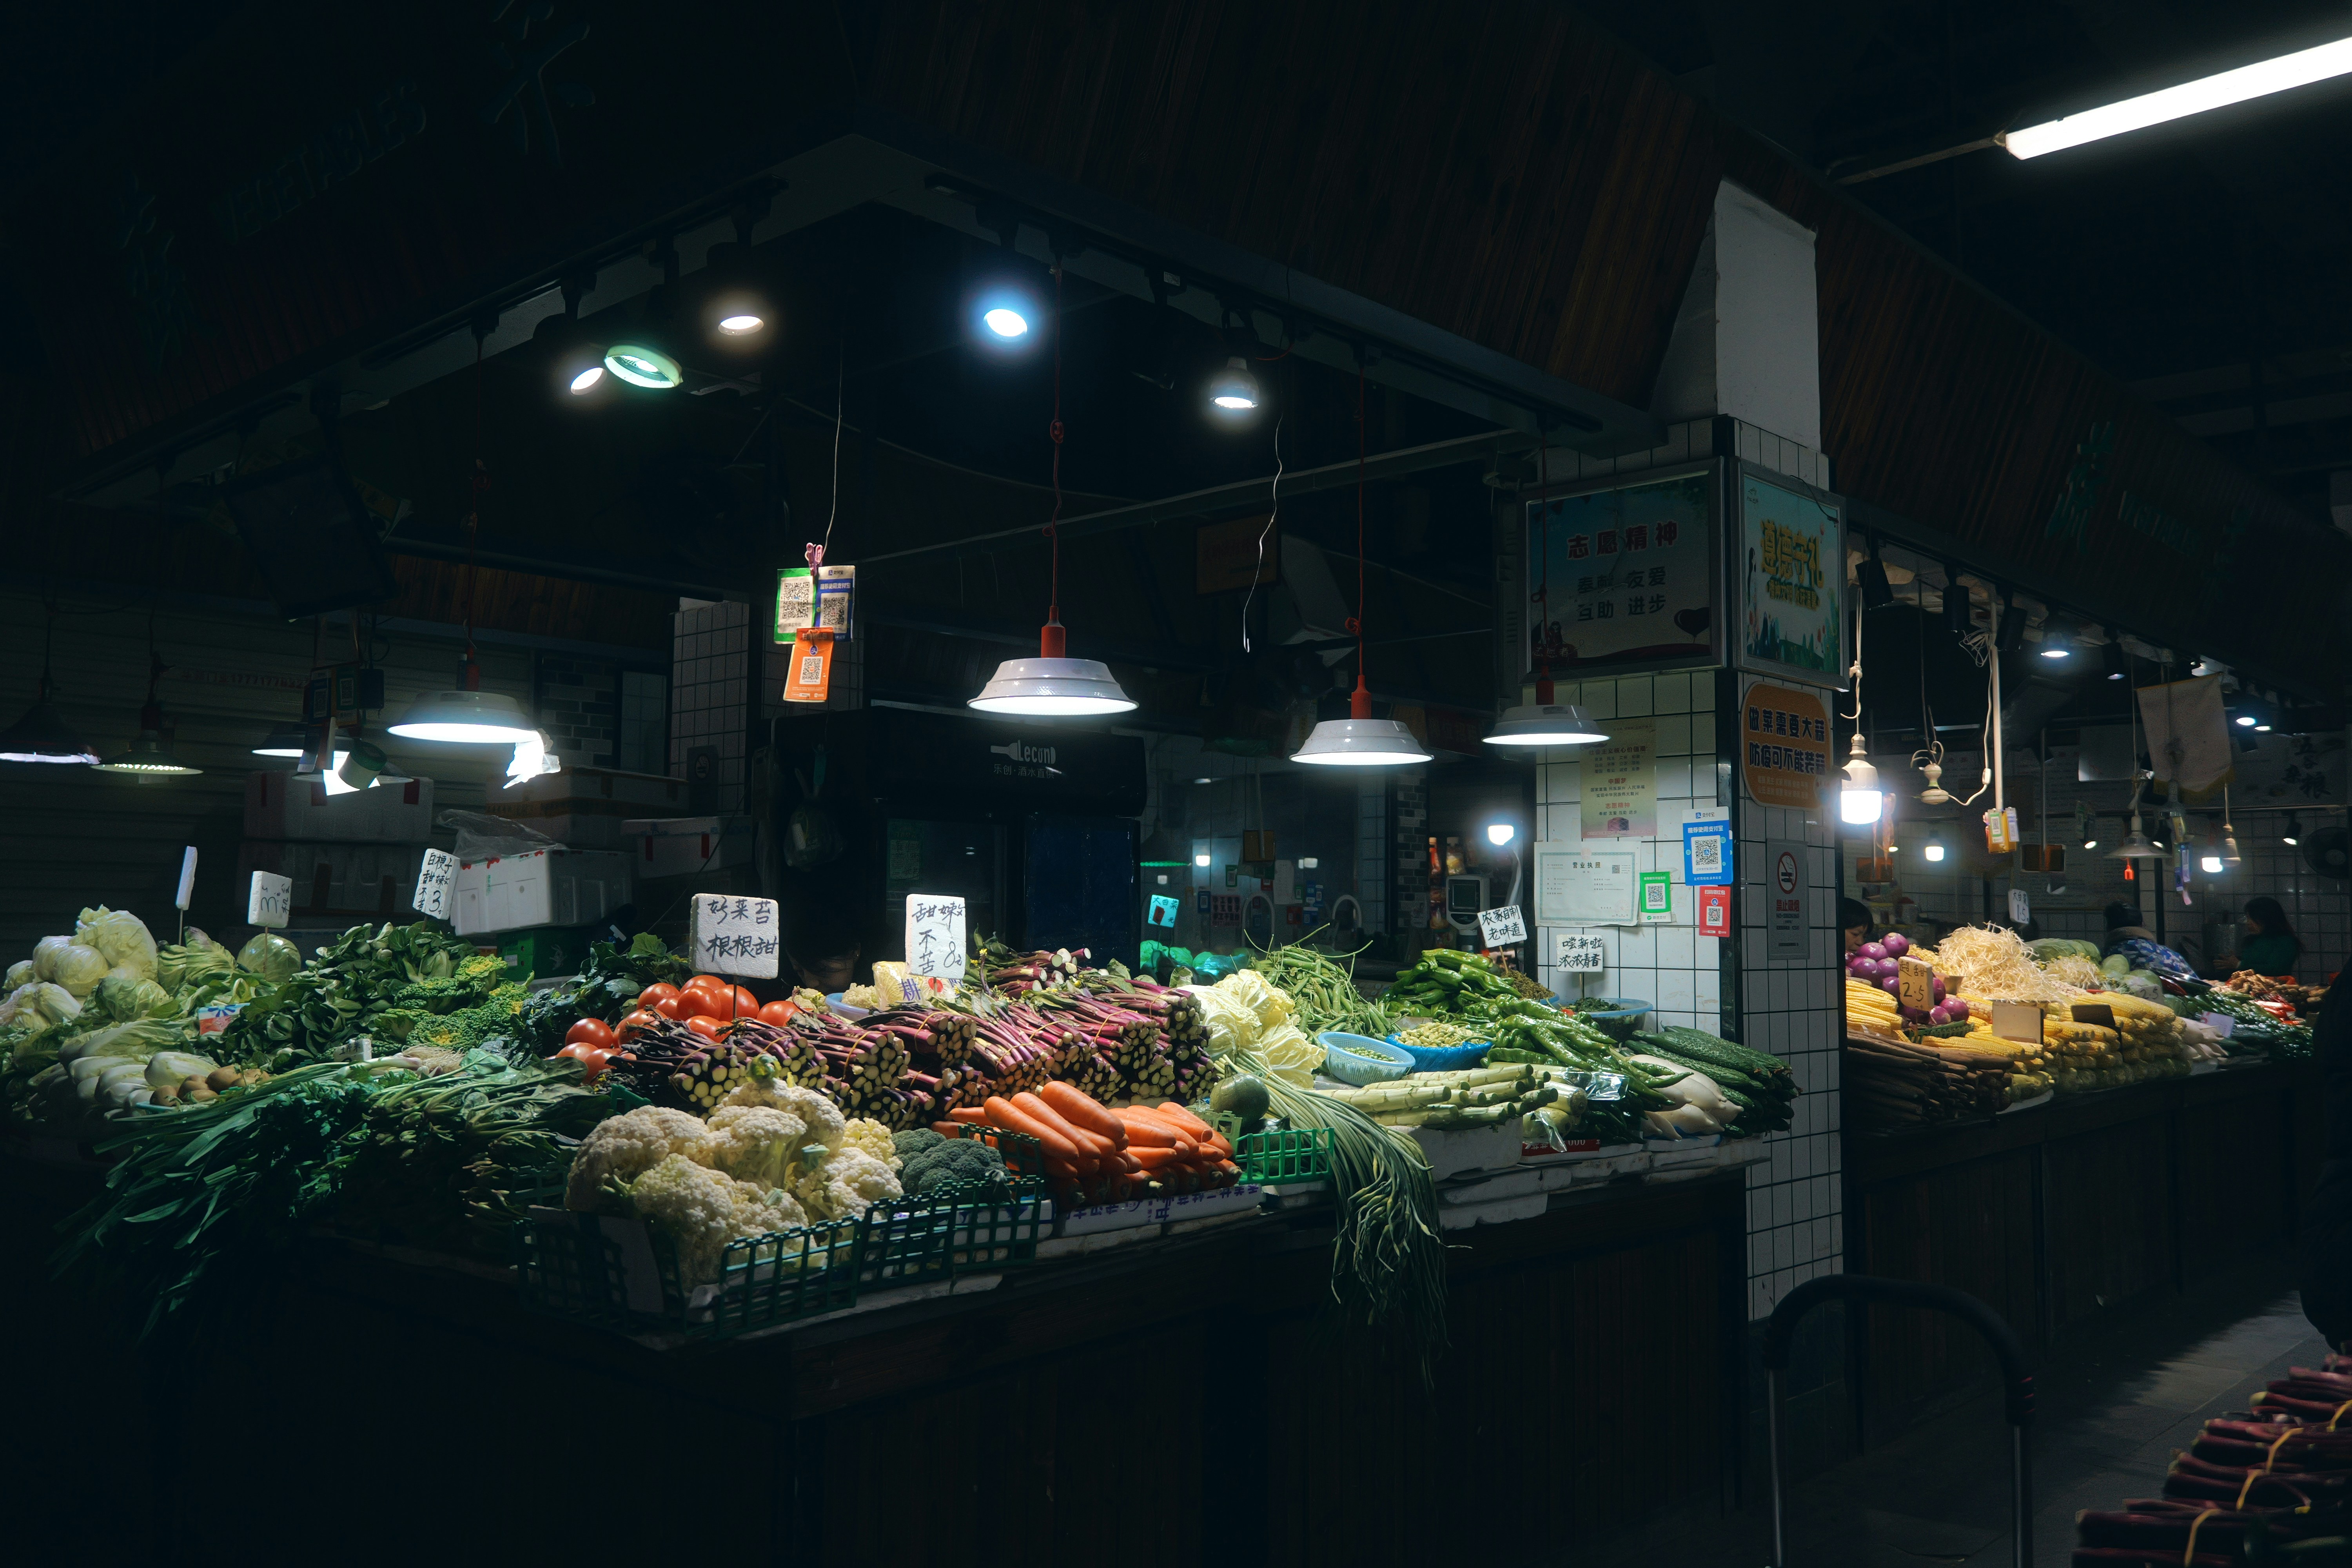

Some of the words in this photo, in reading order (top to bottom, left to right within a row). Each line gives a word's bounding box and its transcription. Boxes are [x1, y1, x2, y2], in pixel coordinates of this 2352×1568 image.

[1568, 521, 1678, 559] 志愿精神
[1760, 519, 1824, 589] 遵德守礼
[1577, 573, 1614, 594] 奉献
[1628, 566, 1666, 589] 友爱
[1577, 601, 1614, 621] 互助
[1628, 594, 1666, 615] 进步
[1749, 706, 1825, 742] 做菜需要大蒜
[1589, 746, 1646, 755] 社会主义核心价值观
[1749, 742, 1825, 775] 防疫可不能装蒜
[993, 764, 1054, 779] 乐创·酒水直供
[1152, 897, 1178, 910] 大白菜
[1776, 899, 1800, 912] 禁止吸烟
[912, 901, 965, 930] 甜嫩
[1482, 906, 1521, 926] 农家自制
[1488, 922, 1524, 940] 老味道
[706, 933, 779, 962] 根根甜
[918, 929, 936, 975] 不苦
[1900, 960, 1927, 977] 超甜
[1902, 982, 1924, 1002] 2.5
[2140, 986, 2159, 999] 2.5
